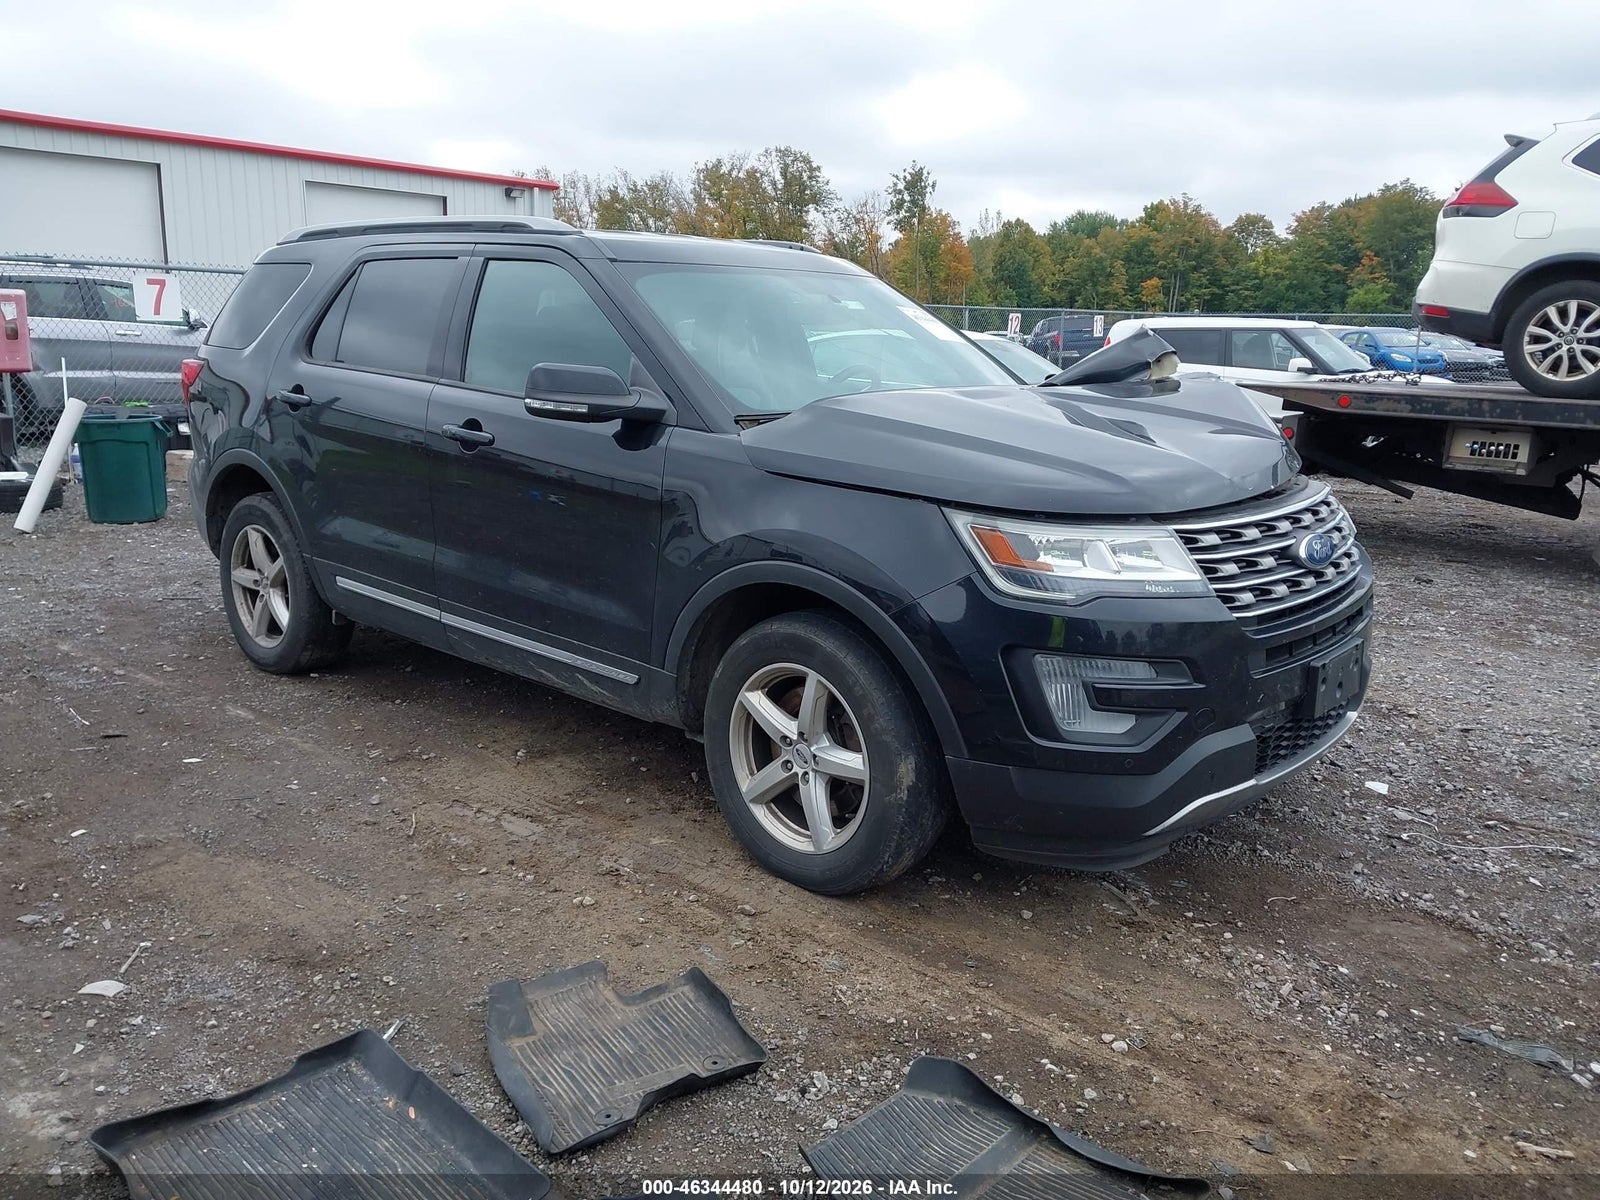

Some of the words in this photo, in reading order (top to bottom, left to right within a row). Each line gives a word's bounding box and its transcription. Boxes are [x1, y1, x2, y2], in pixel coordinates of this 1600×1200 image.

[146, 278, 167, 316] 7
[1009, 315, 1020, 335] 12
[1094, 317, 1104, 335] 13
[1312, 539, 1332, 560] Ford
